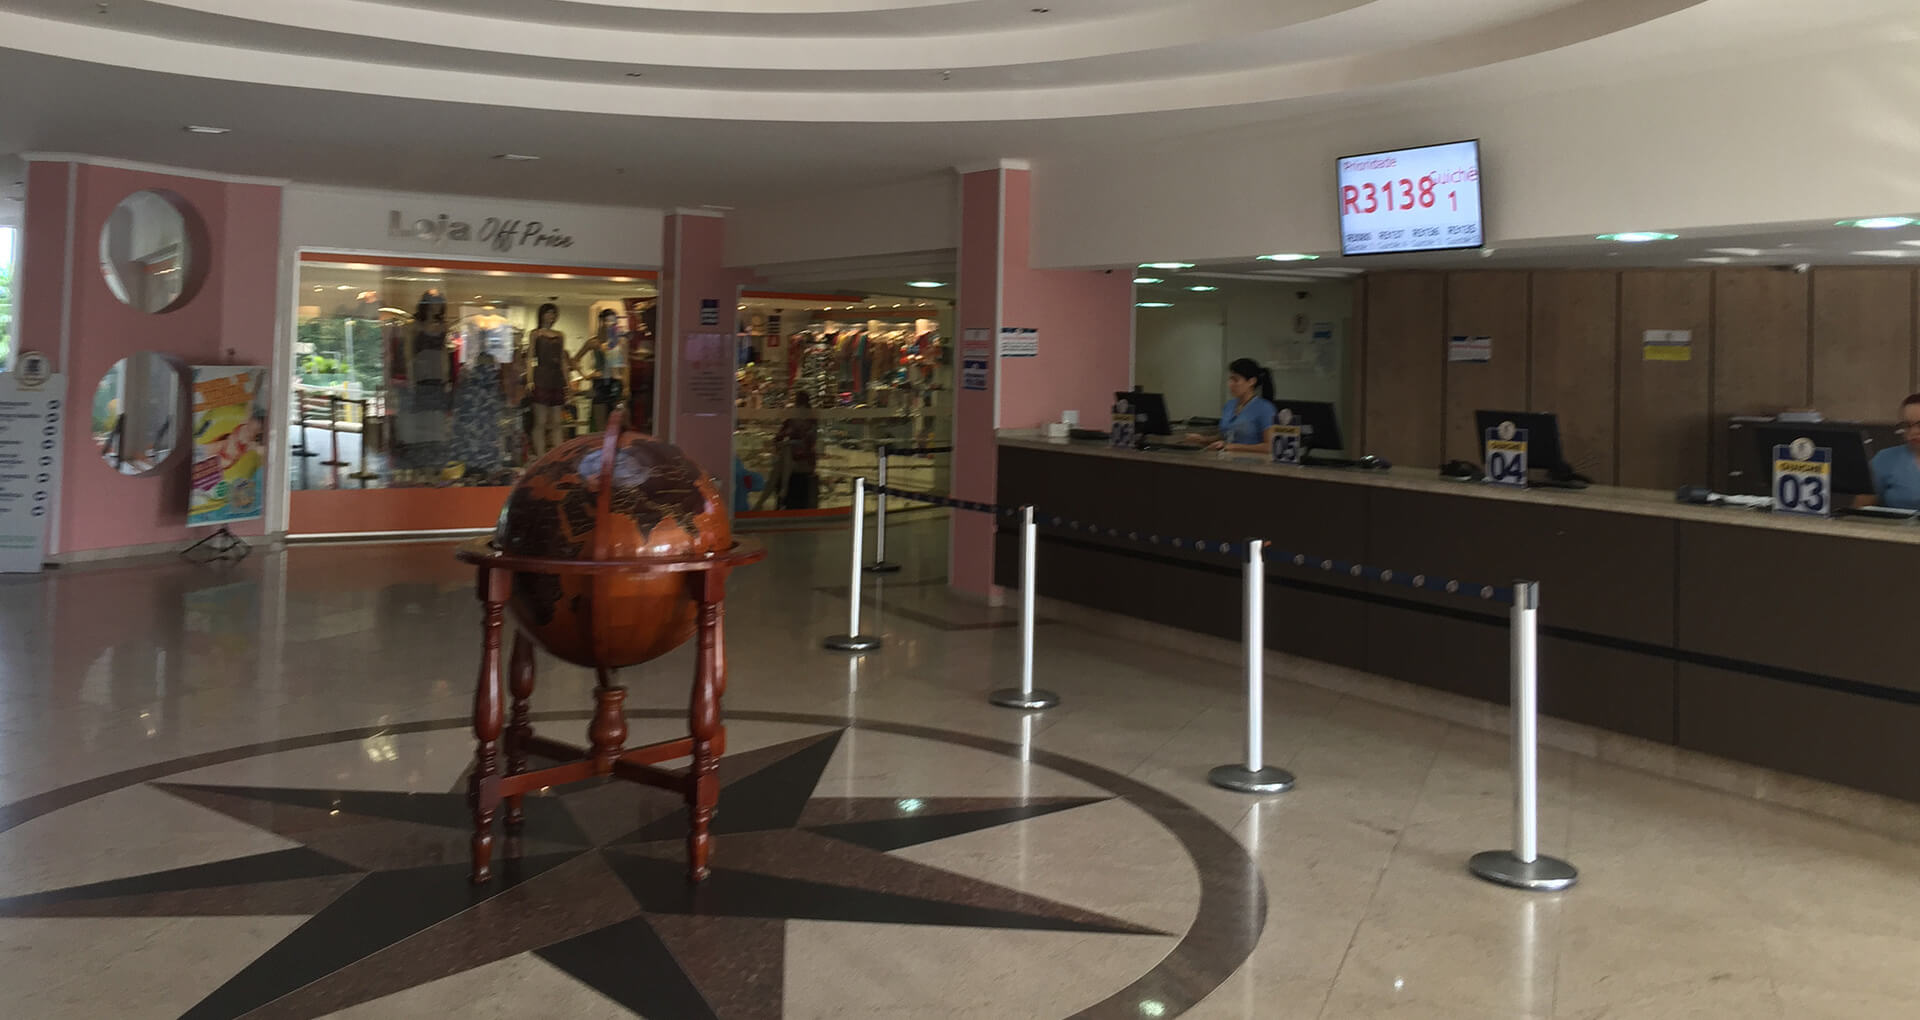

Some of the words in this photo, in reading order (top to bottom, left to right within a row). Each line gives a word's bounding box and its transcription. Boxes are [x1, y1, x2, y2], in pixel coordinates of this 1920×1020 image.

[1342, 176, 1435, 216] R3138
[1448, 190, 1457, 211] 1
[388, 210, 473, 244] Loja
[478, 217, 521, 252] Off
[519, 221, 575, 248] Price
[1273, 435, 1296, 460] 05
[1491, 452, 1522, 480] 04
[1779, 474, 1823, 511] 03
